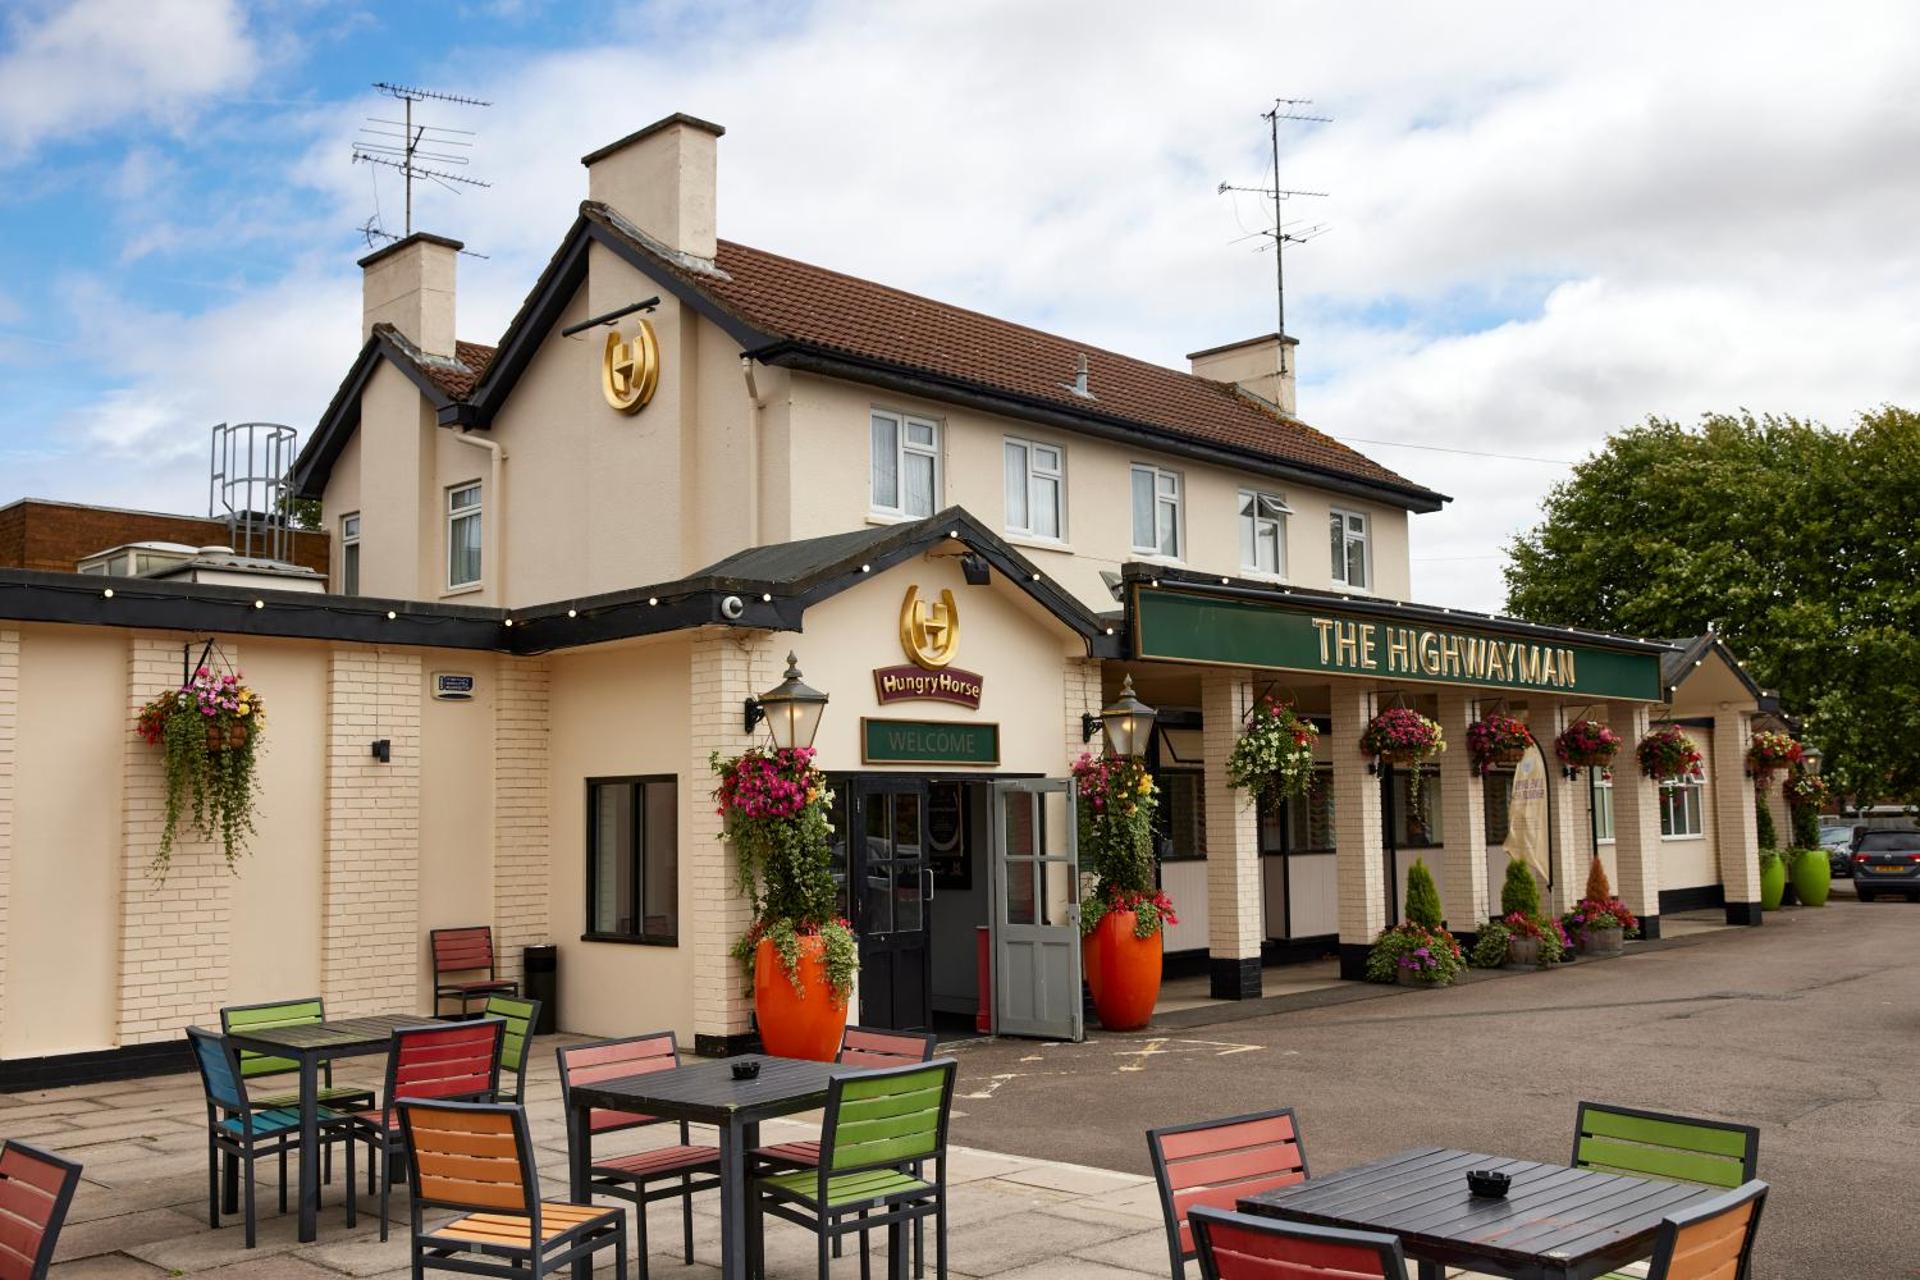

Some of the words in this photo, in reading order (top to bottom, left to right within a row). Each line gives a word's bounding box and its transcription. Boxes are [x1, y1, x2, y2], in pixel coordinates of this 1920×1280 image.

[1312, 617, 1377, 669] THE
[1386, 627, 1576, 688] HIGHWAYMAN
[888, 731, 976, 754] WELCOME
